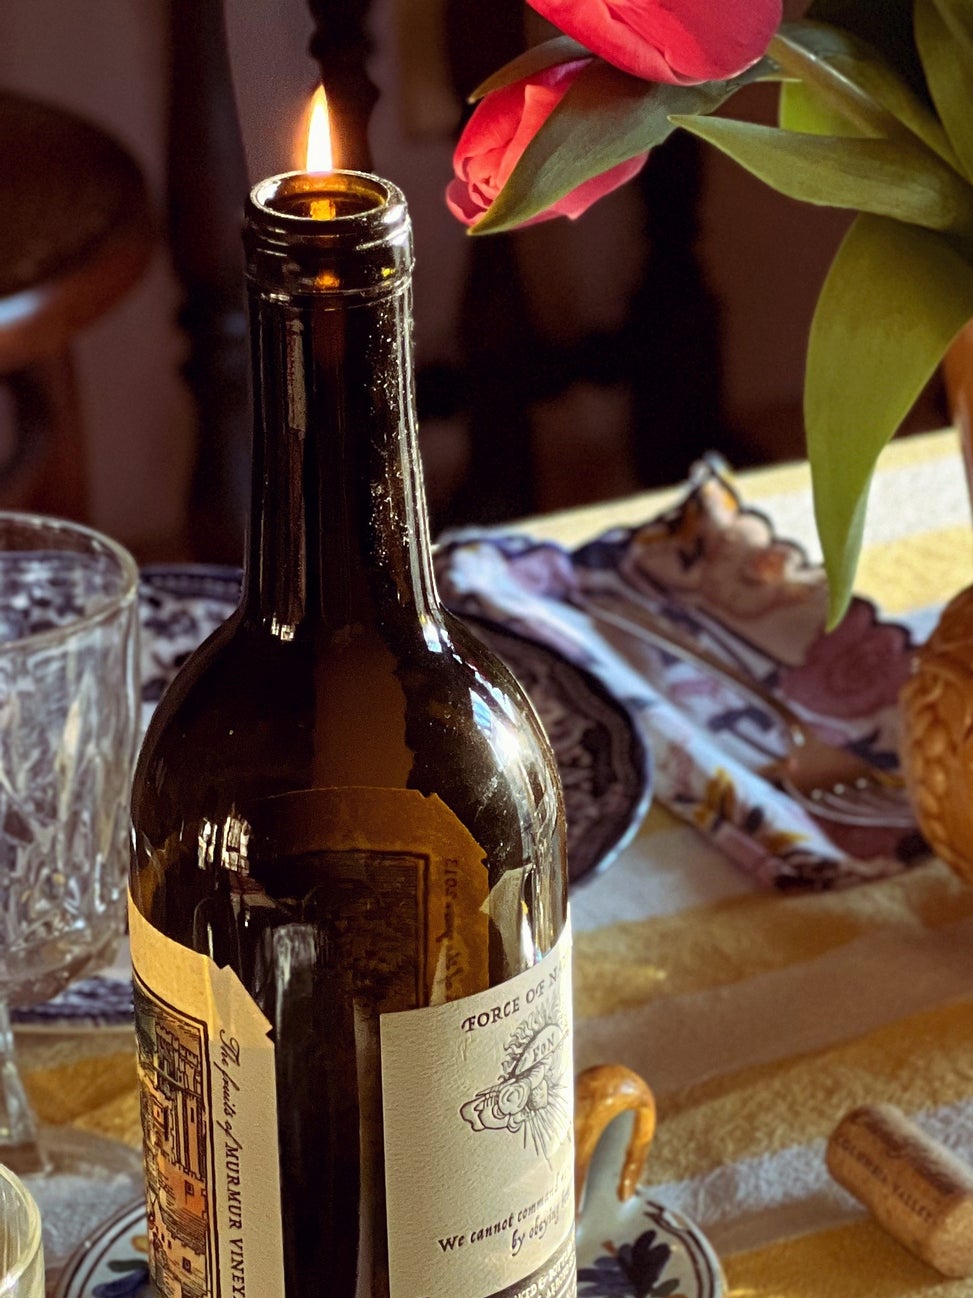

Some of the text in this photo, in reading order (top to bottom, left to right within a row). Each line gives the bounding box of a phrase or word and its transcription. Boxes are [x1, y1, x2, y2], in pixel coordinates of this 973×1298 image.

[461, 979, 545, 1032] FORCE OF
[219, 1028, 240, 1067] The
[214, 1061, 240, 1119] fruits
[216, 1120, 243, 1150] of
[225, 1141, 242, 1229] MURMUR
[892, 1183, 935, 1222] VALLEY
[438, 1233, 465, 1252] We
[470, 1212, 515, 1244] cannot
[511, 1228, 525, 1257] by
